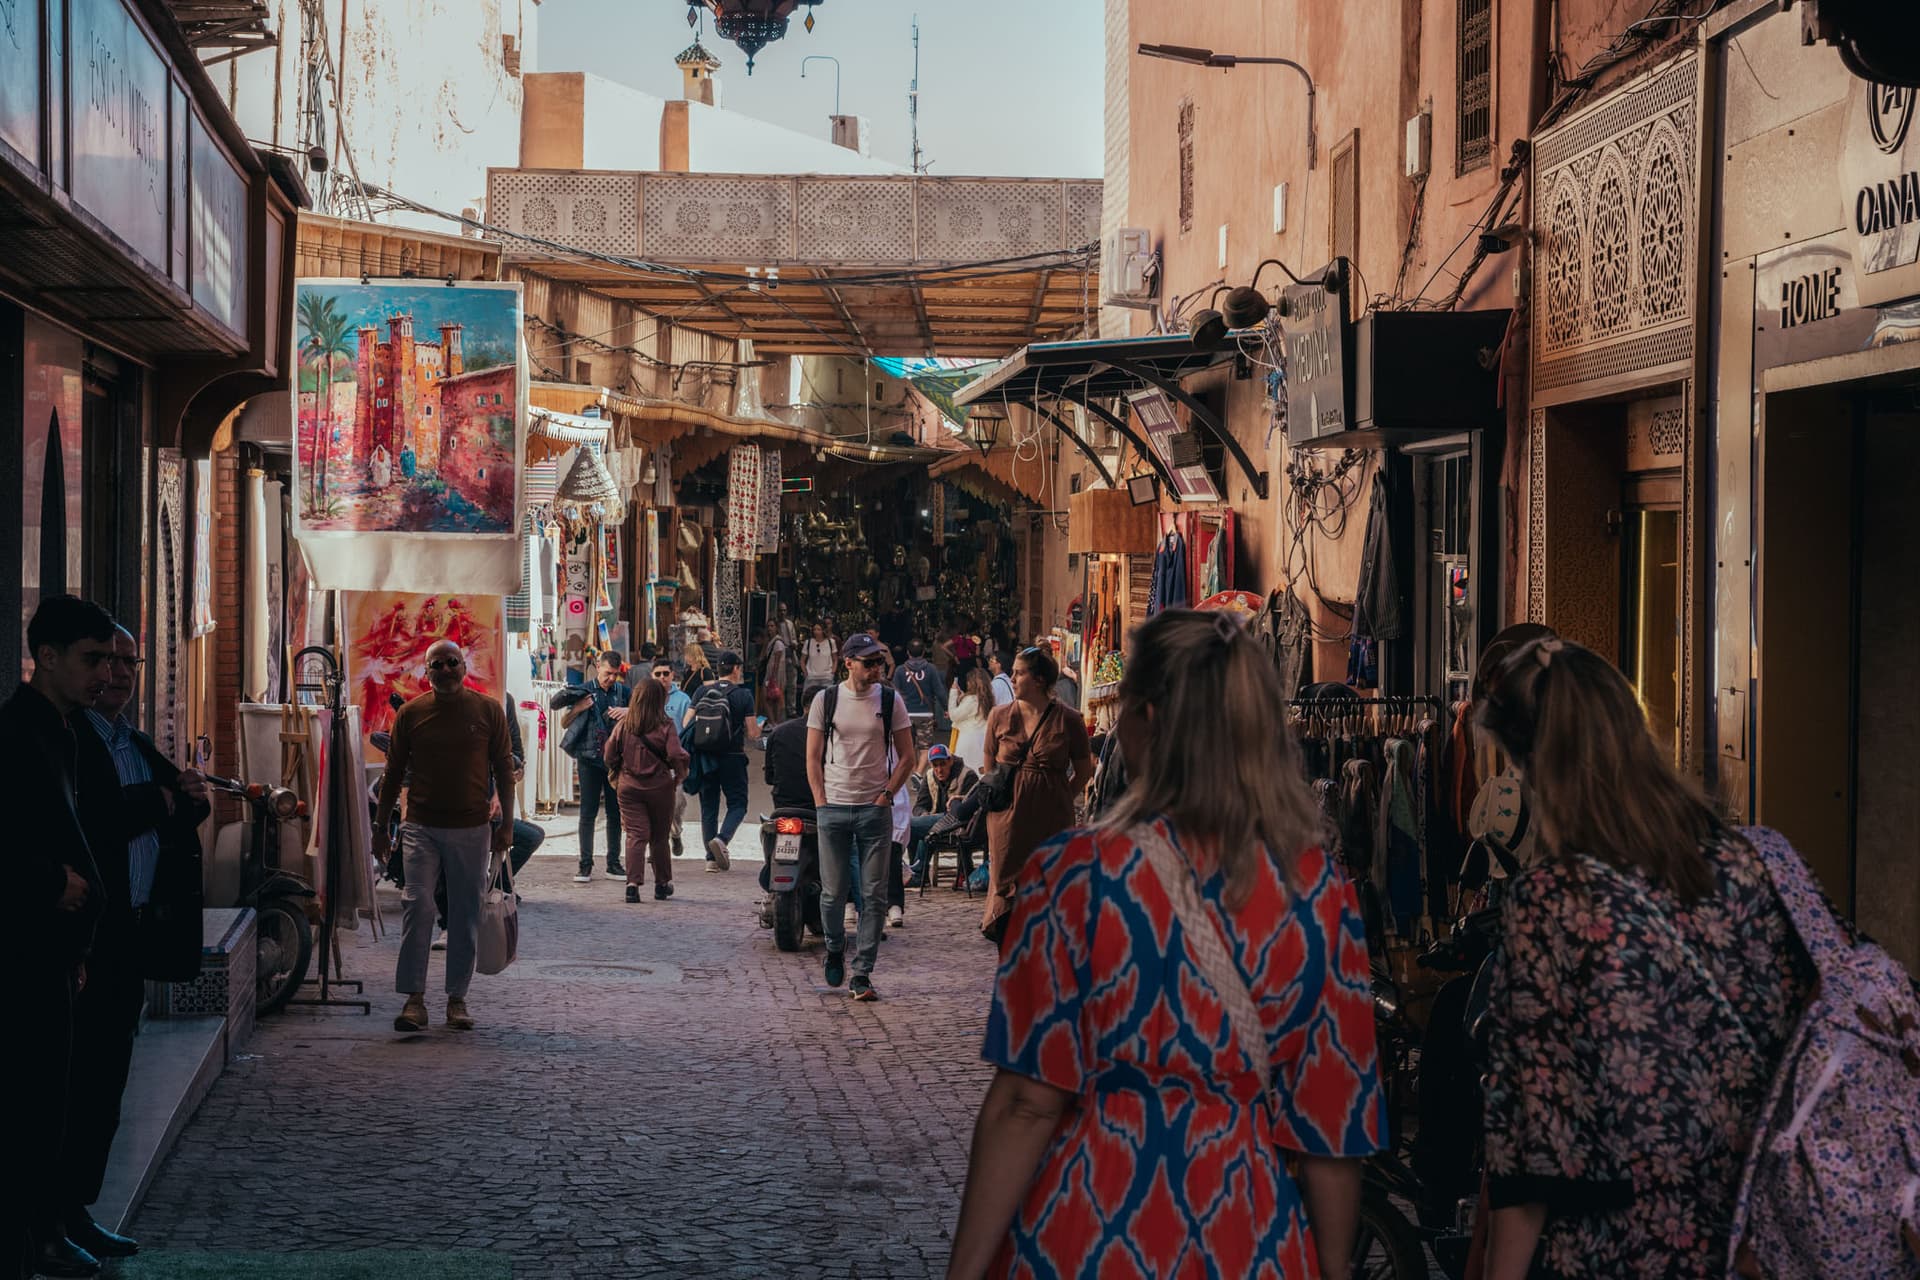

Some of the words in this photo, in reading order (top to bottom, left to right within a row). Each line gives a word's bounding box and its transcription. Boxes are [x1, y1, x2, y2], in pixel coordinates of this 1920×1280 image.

[1779, 266, 1842, 329] HOME
[1294, 326, 1331, 384] MEDINA
[905, 670, 925, 682] 70
